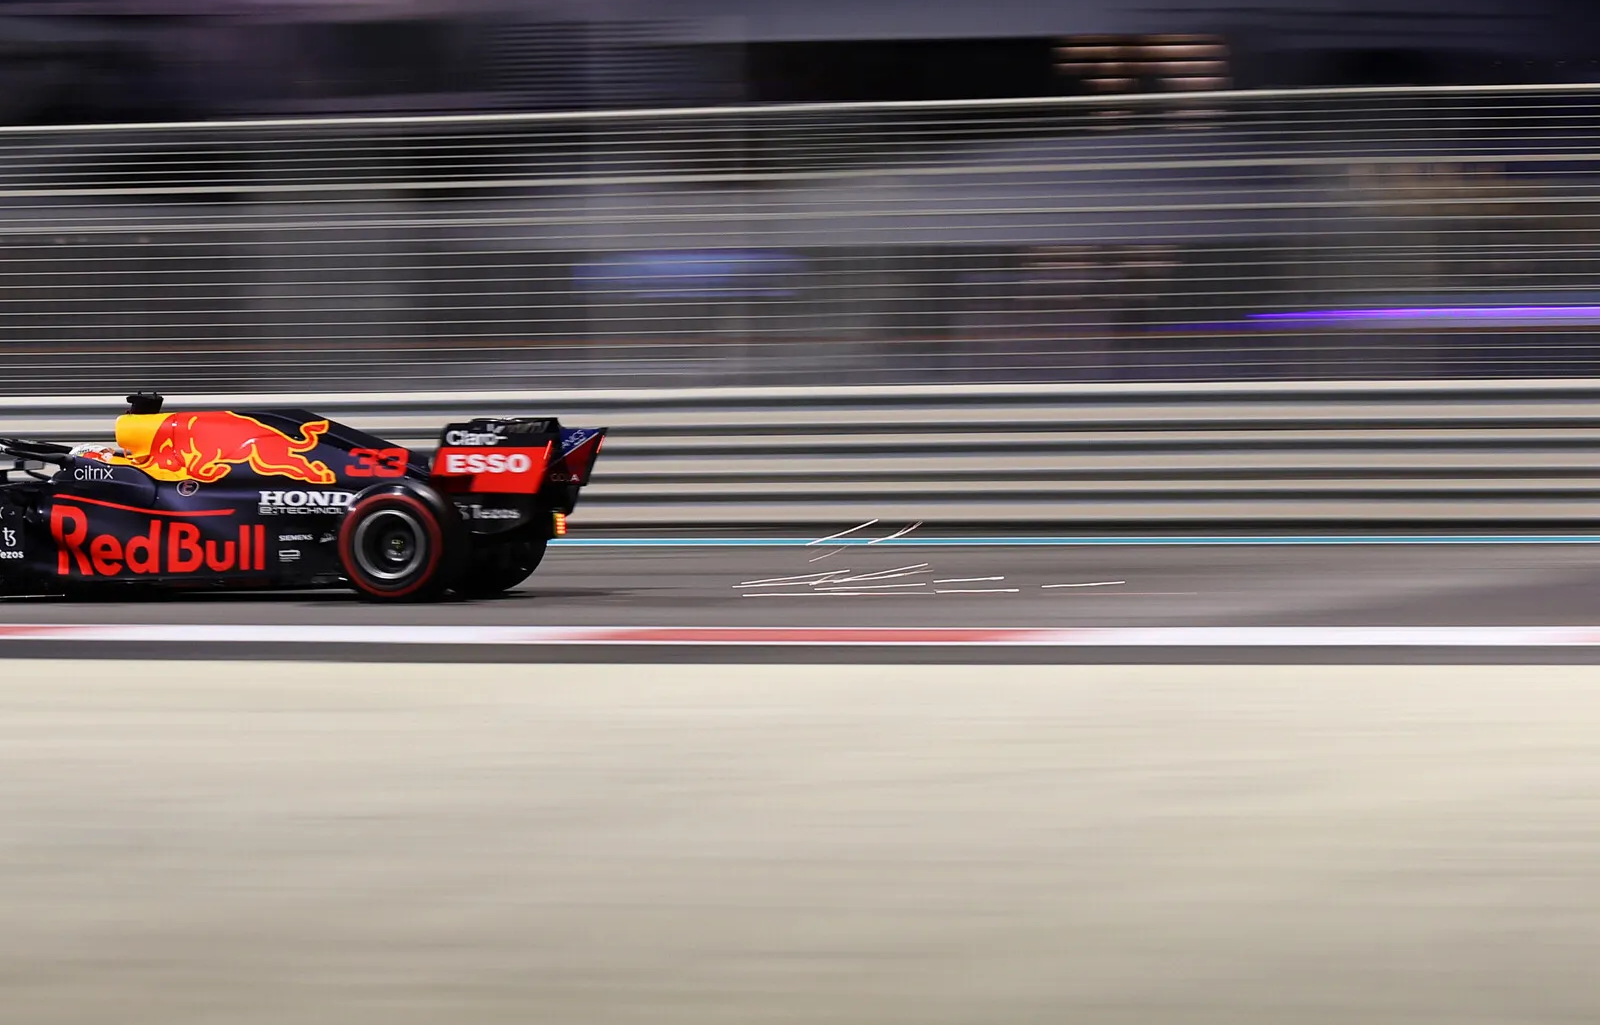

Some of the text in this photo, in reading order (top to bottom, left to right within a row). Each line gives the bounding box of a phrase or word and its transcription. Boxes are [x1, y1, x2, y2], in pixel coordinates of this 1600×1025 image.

[446, 430, 498, 446] Claro
[345, 448, 409, 477] 33
[446, 454, 532, 474] ESSO
[74, 465, 114, 480] citrix
[258, 490, 353, 506] HOND
[50, 504, 266, 576] Red Bull
